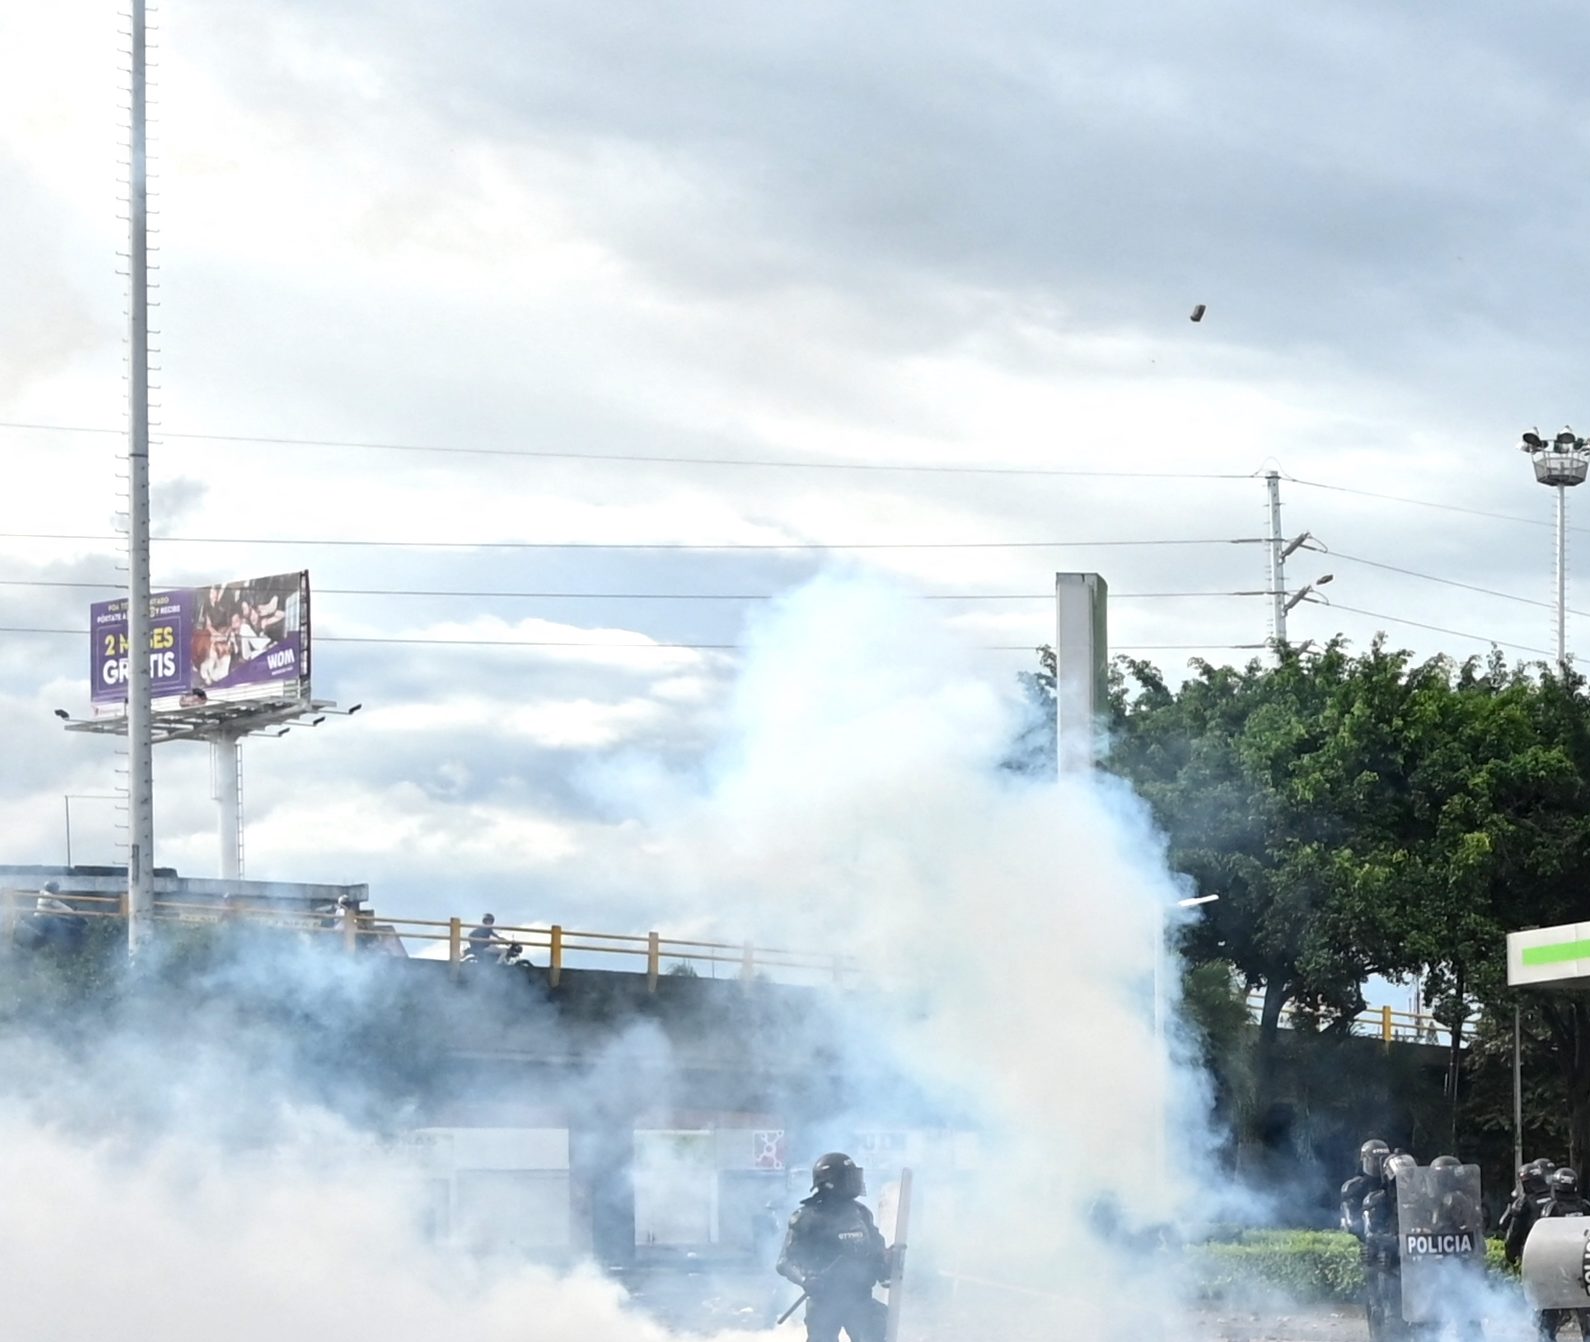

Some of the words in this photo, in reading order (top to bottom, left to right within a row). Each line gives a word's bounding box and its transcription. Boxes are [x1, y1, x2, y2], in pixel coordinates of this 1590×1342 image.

[104, 634, 116, 656] 2
[102, 651, 176, 685] GRTIS
[266, 647, 296, 670] WOM
[1407, 1234, 1473, 1254] POLICIA
